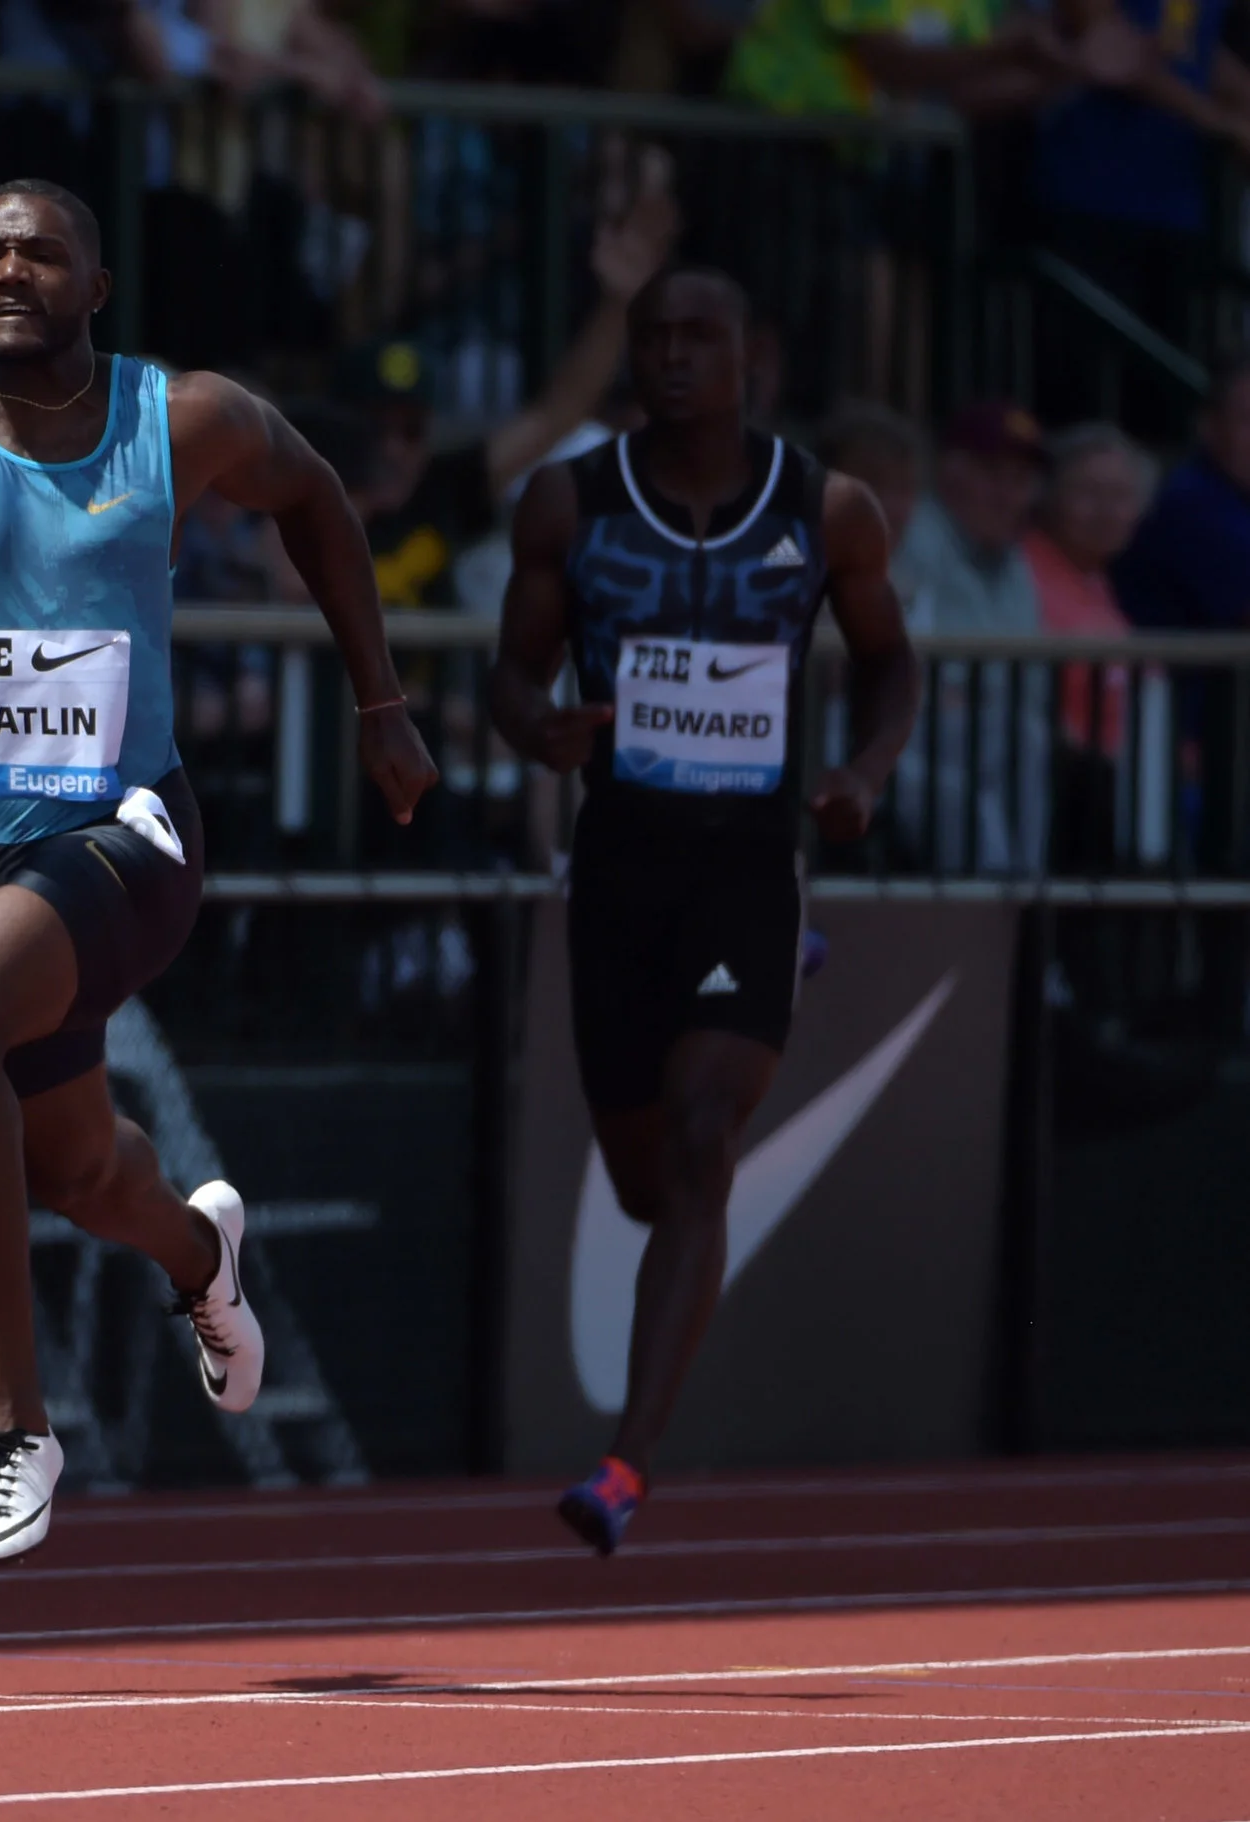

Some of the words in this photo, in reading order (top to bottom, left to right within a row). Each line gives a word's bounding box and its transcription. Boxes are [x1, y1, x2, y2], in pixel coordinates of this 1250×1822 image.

[630, 644, 692, 685] PRE
[631, 701, 772, 739] EDWARD
[8, 766, 109, 797] Eugene
